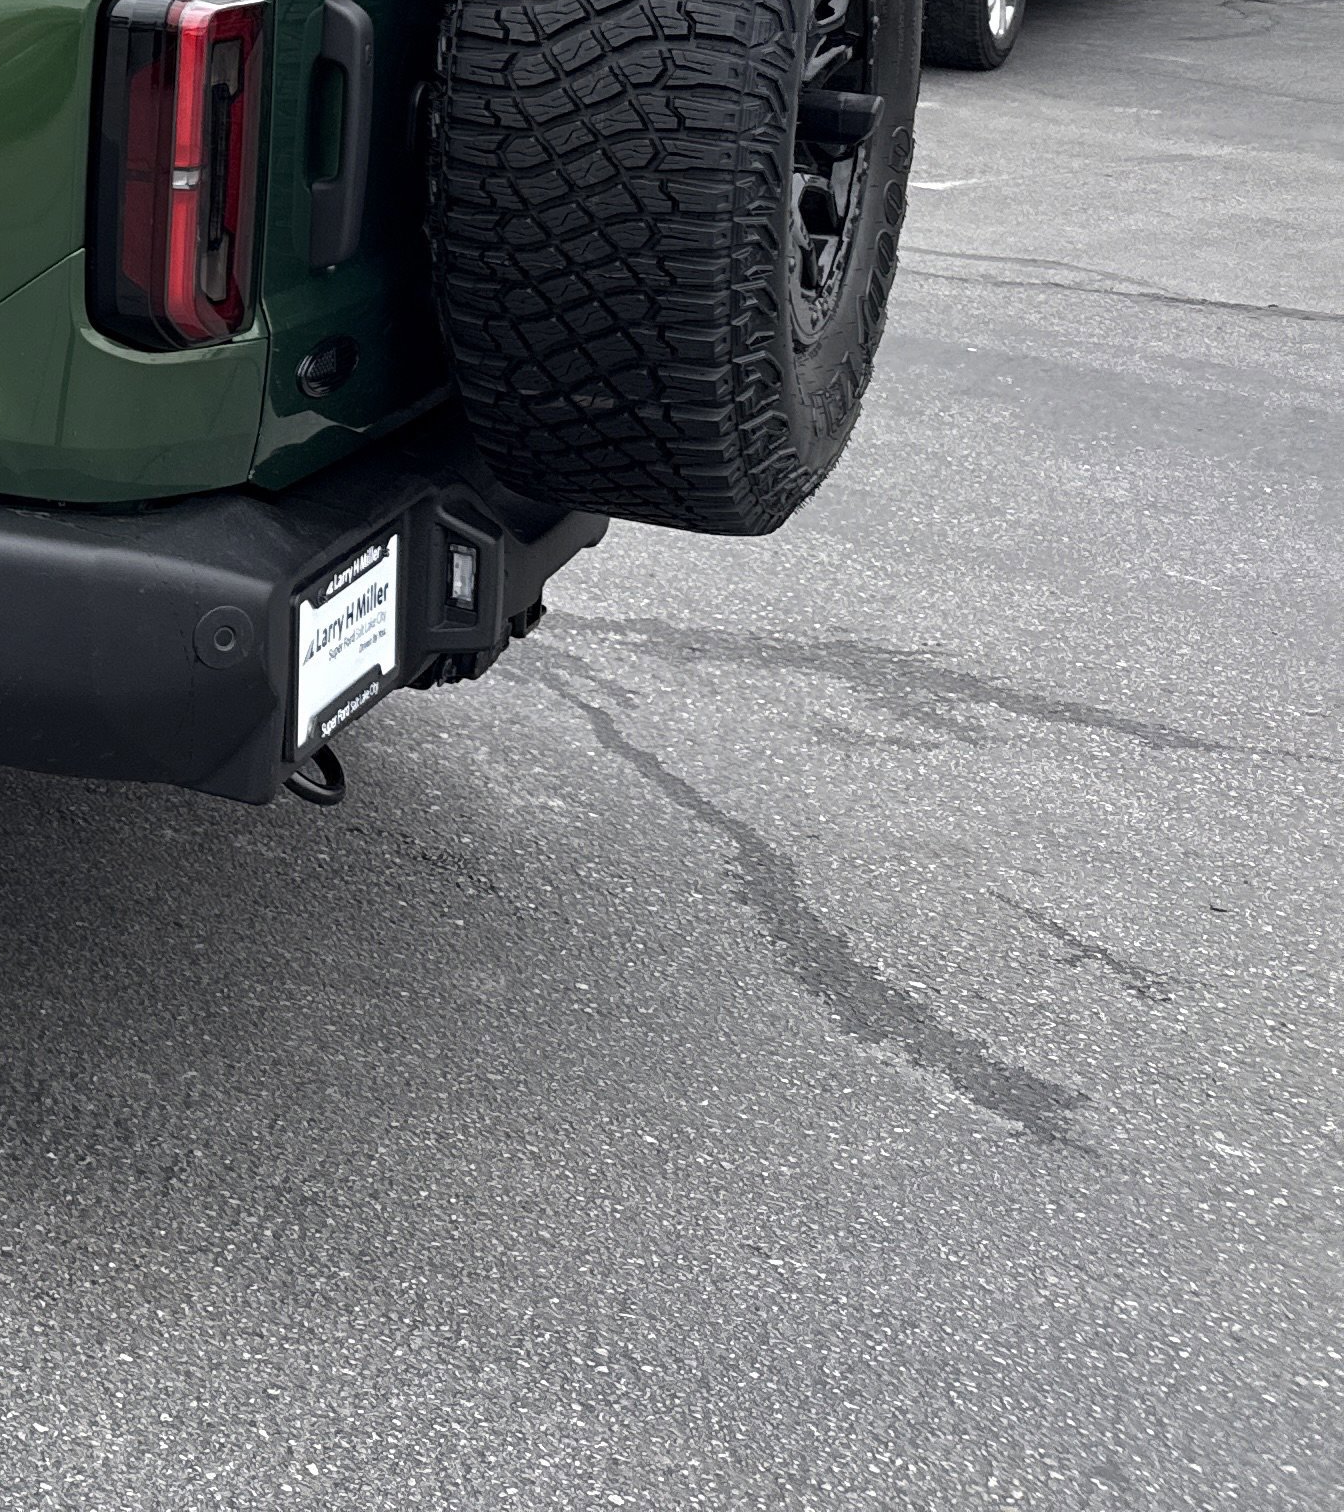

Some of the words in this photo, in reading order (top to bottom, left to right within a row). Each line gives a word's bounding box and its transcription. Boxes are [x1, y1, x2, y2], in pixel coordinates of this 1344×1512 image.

[334, 566, 353, 590] Larry
[359, 546, 382, 571] Miller
[316, 615, 344, 652] Larry
[346, 602, 354, 629] H
[356, 582, 389, 622] Miller
[321, 715, 337, 738] Super
[337, 701, 350, 725] Ford
